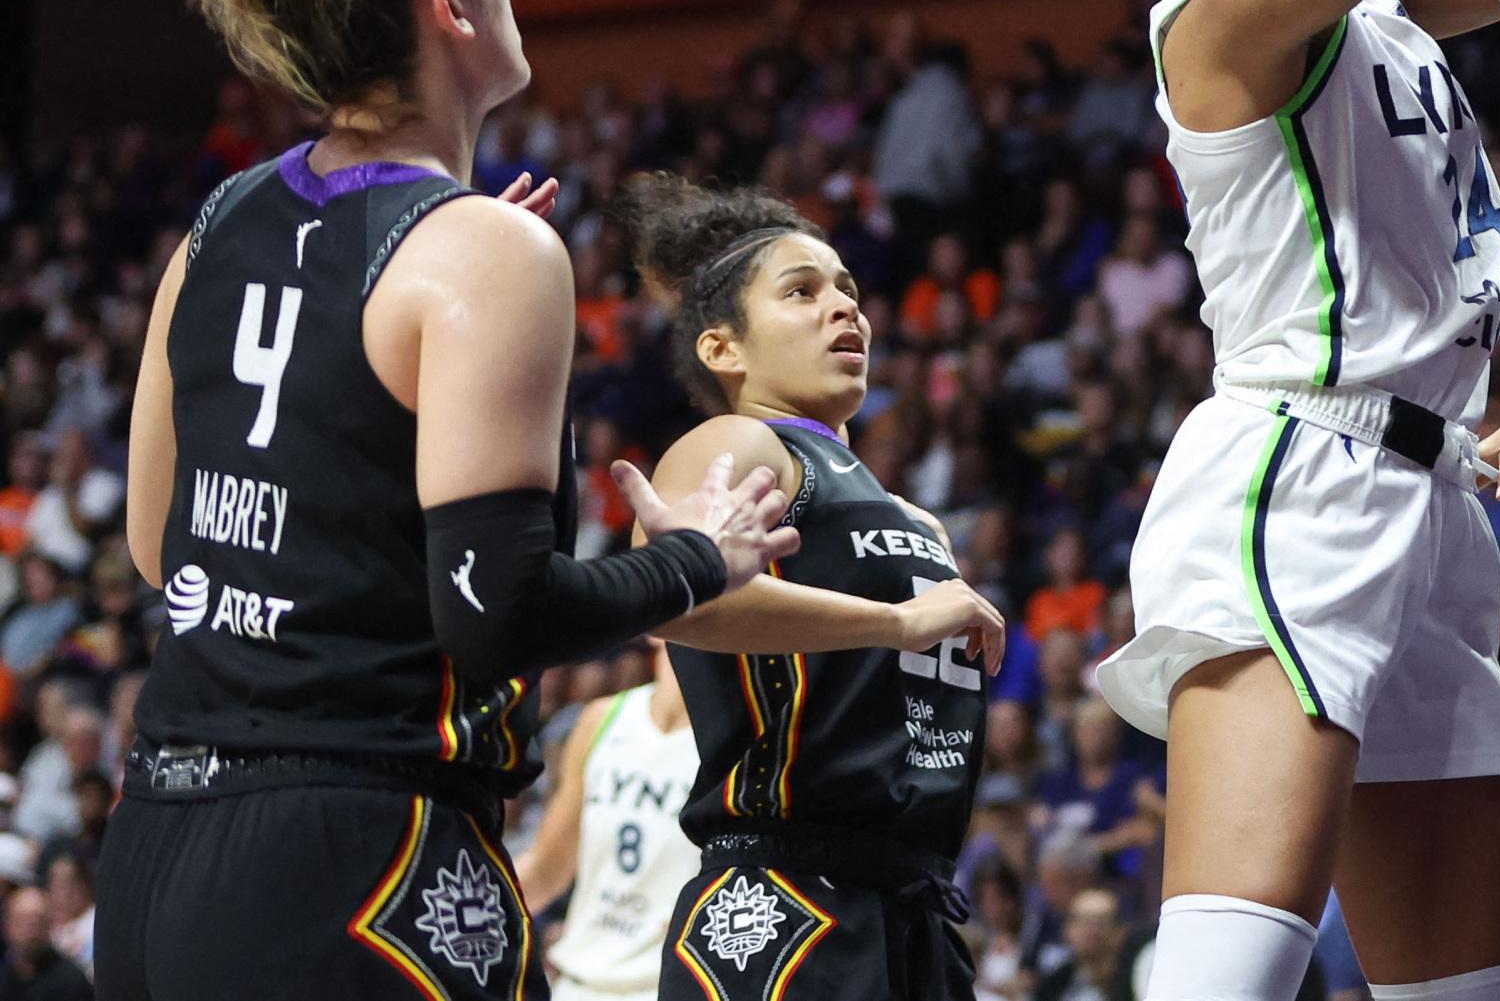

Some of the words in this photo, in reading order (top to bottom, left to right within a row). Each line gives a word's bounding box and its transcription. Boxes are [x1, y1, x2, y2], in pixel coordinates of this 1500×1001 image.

[1372, 59, 1476, 138] LYN
[232, 282, 303, 449] 4
[190, 468, 288, 556] MABREY
[211, 585, 294, 642] AT&T
[905, 695, 934, 721] Yale
[905, 743, 965, 769] Health
[617, 822, 641, 874] 8
